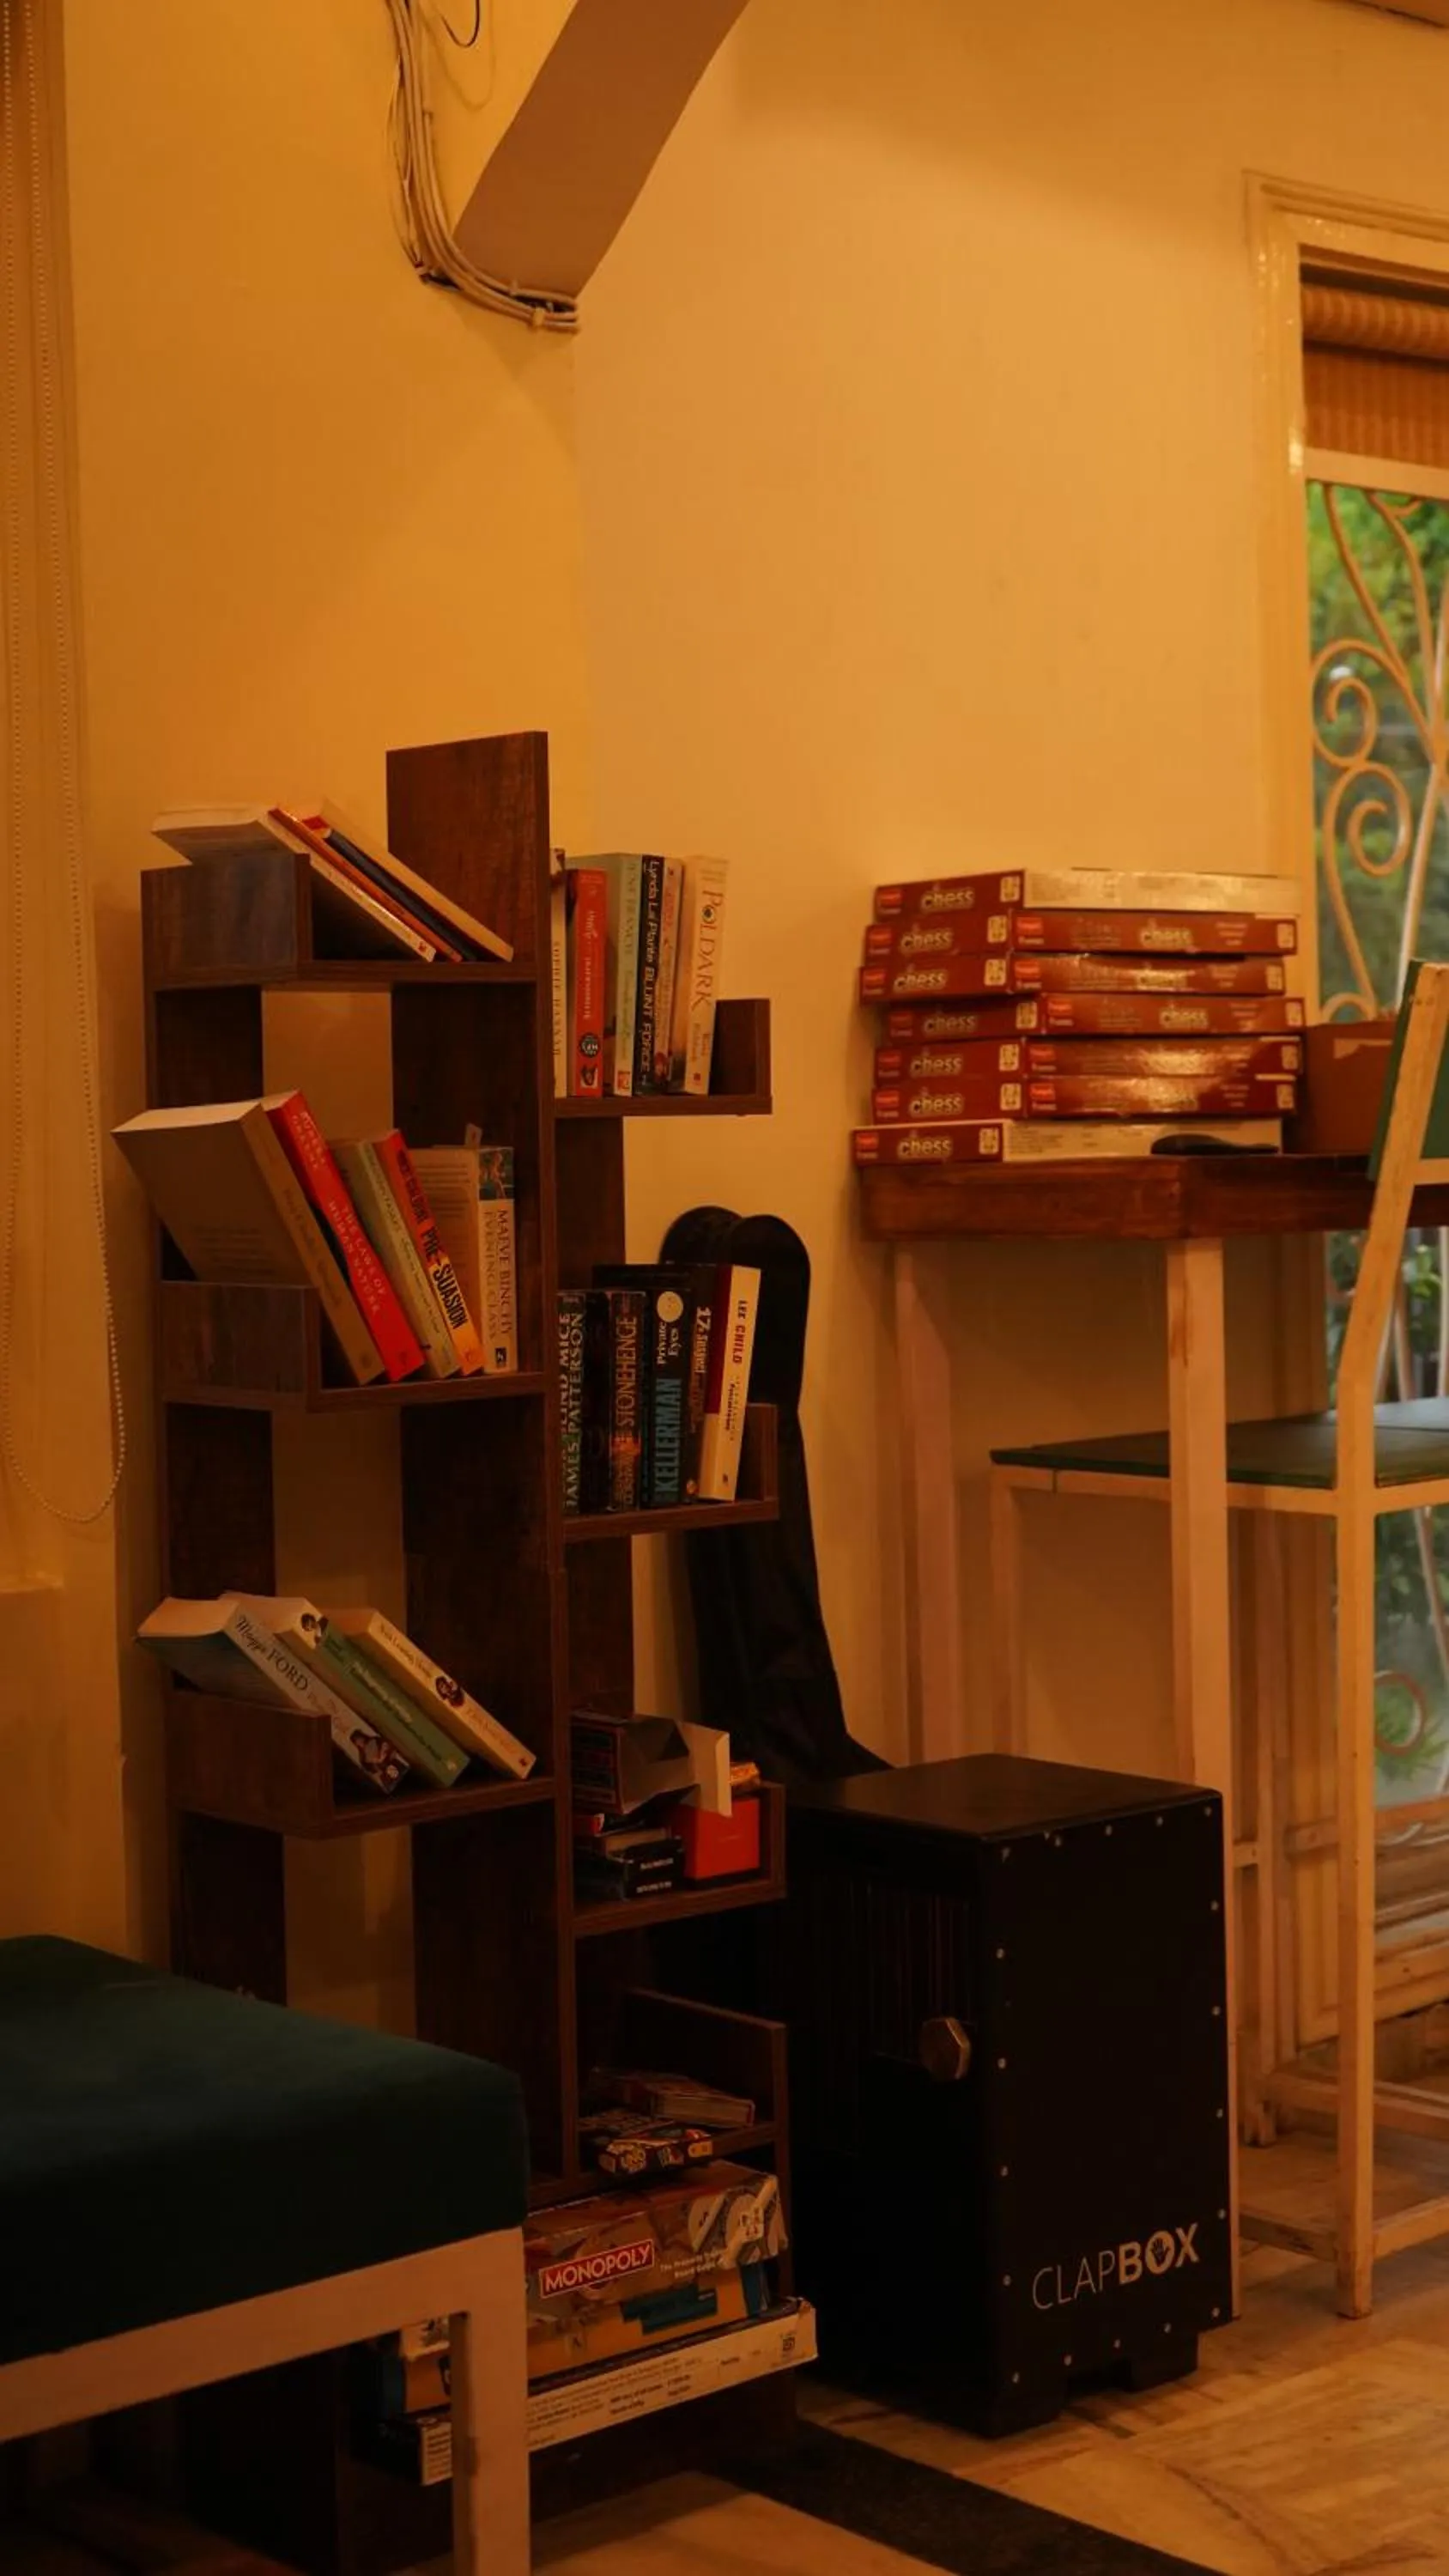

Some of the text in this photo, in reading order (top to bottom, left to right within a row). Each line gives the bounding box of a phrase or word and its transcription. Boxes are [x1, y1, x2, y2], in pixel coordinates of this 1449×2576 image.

[921, 887, 974, 911] chess
[689, 890, 725, 1012] POLDARK
[901, 928, 953, 951] chess
[642, 966, 655, 1018] BLUNT
[894, 970, 945, 991] chess
[924, 1013, 977, 1033] chess
[639, 1022, 651, 1073] FORCE
[910, 1055, 962, 1076] chess
[908, 1094, 963, 1115] chess
[898, 1137, 952, 1157] chess
[495, 1209, 511, 1266] MAEVE
[420, 1225, 470, 1330] PRE-SUASION
[737, 1300, 749, 1320] LEE
[558, 1311, 570, 1367] MICE
[655, 1321, 668, 1366] Private
[667, 1327, 683, 1358] Eyes
[731, 1324, 747, 1364] CHILD
[615, 1315, 638, 1427] STONEHENGE
[565, 1312, 585, 1509] JAMES PATTERSON
[653, 1377, 683, 1492] KELLERMAN
[266, 1648, 309, 1692] FORD
[543, 2244, 652, 2293] MONOPOLY
[1031, 2221, 1201, 2311] CLAPBOX
